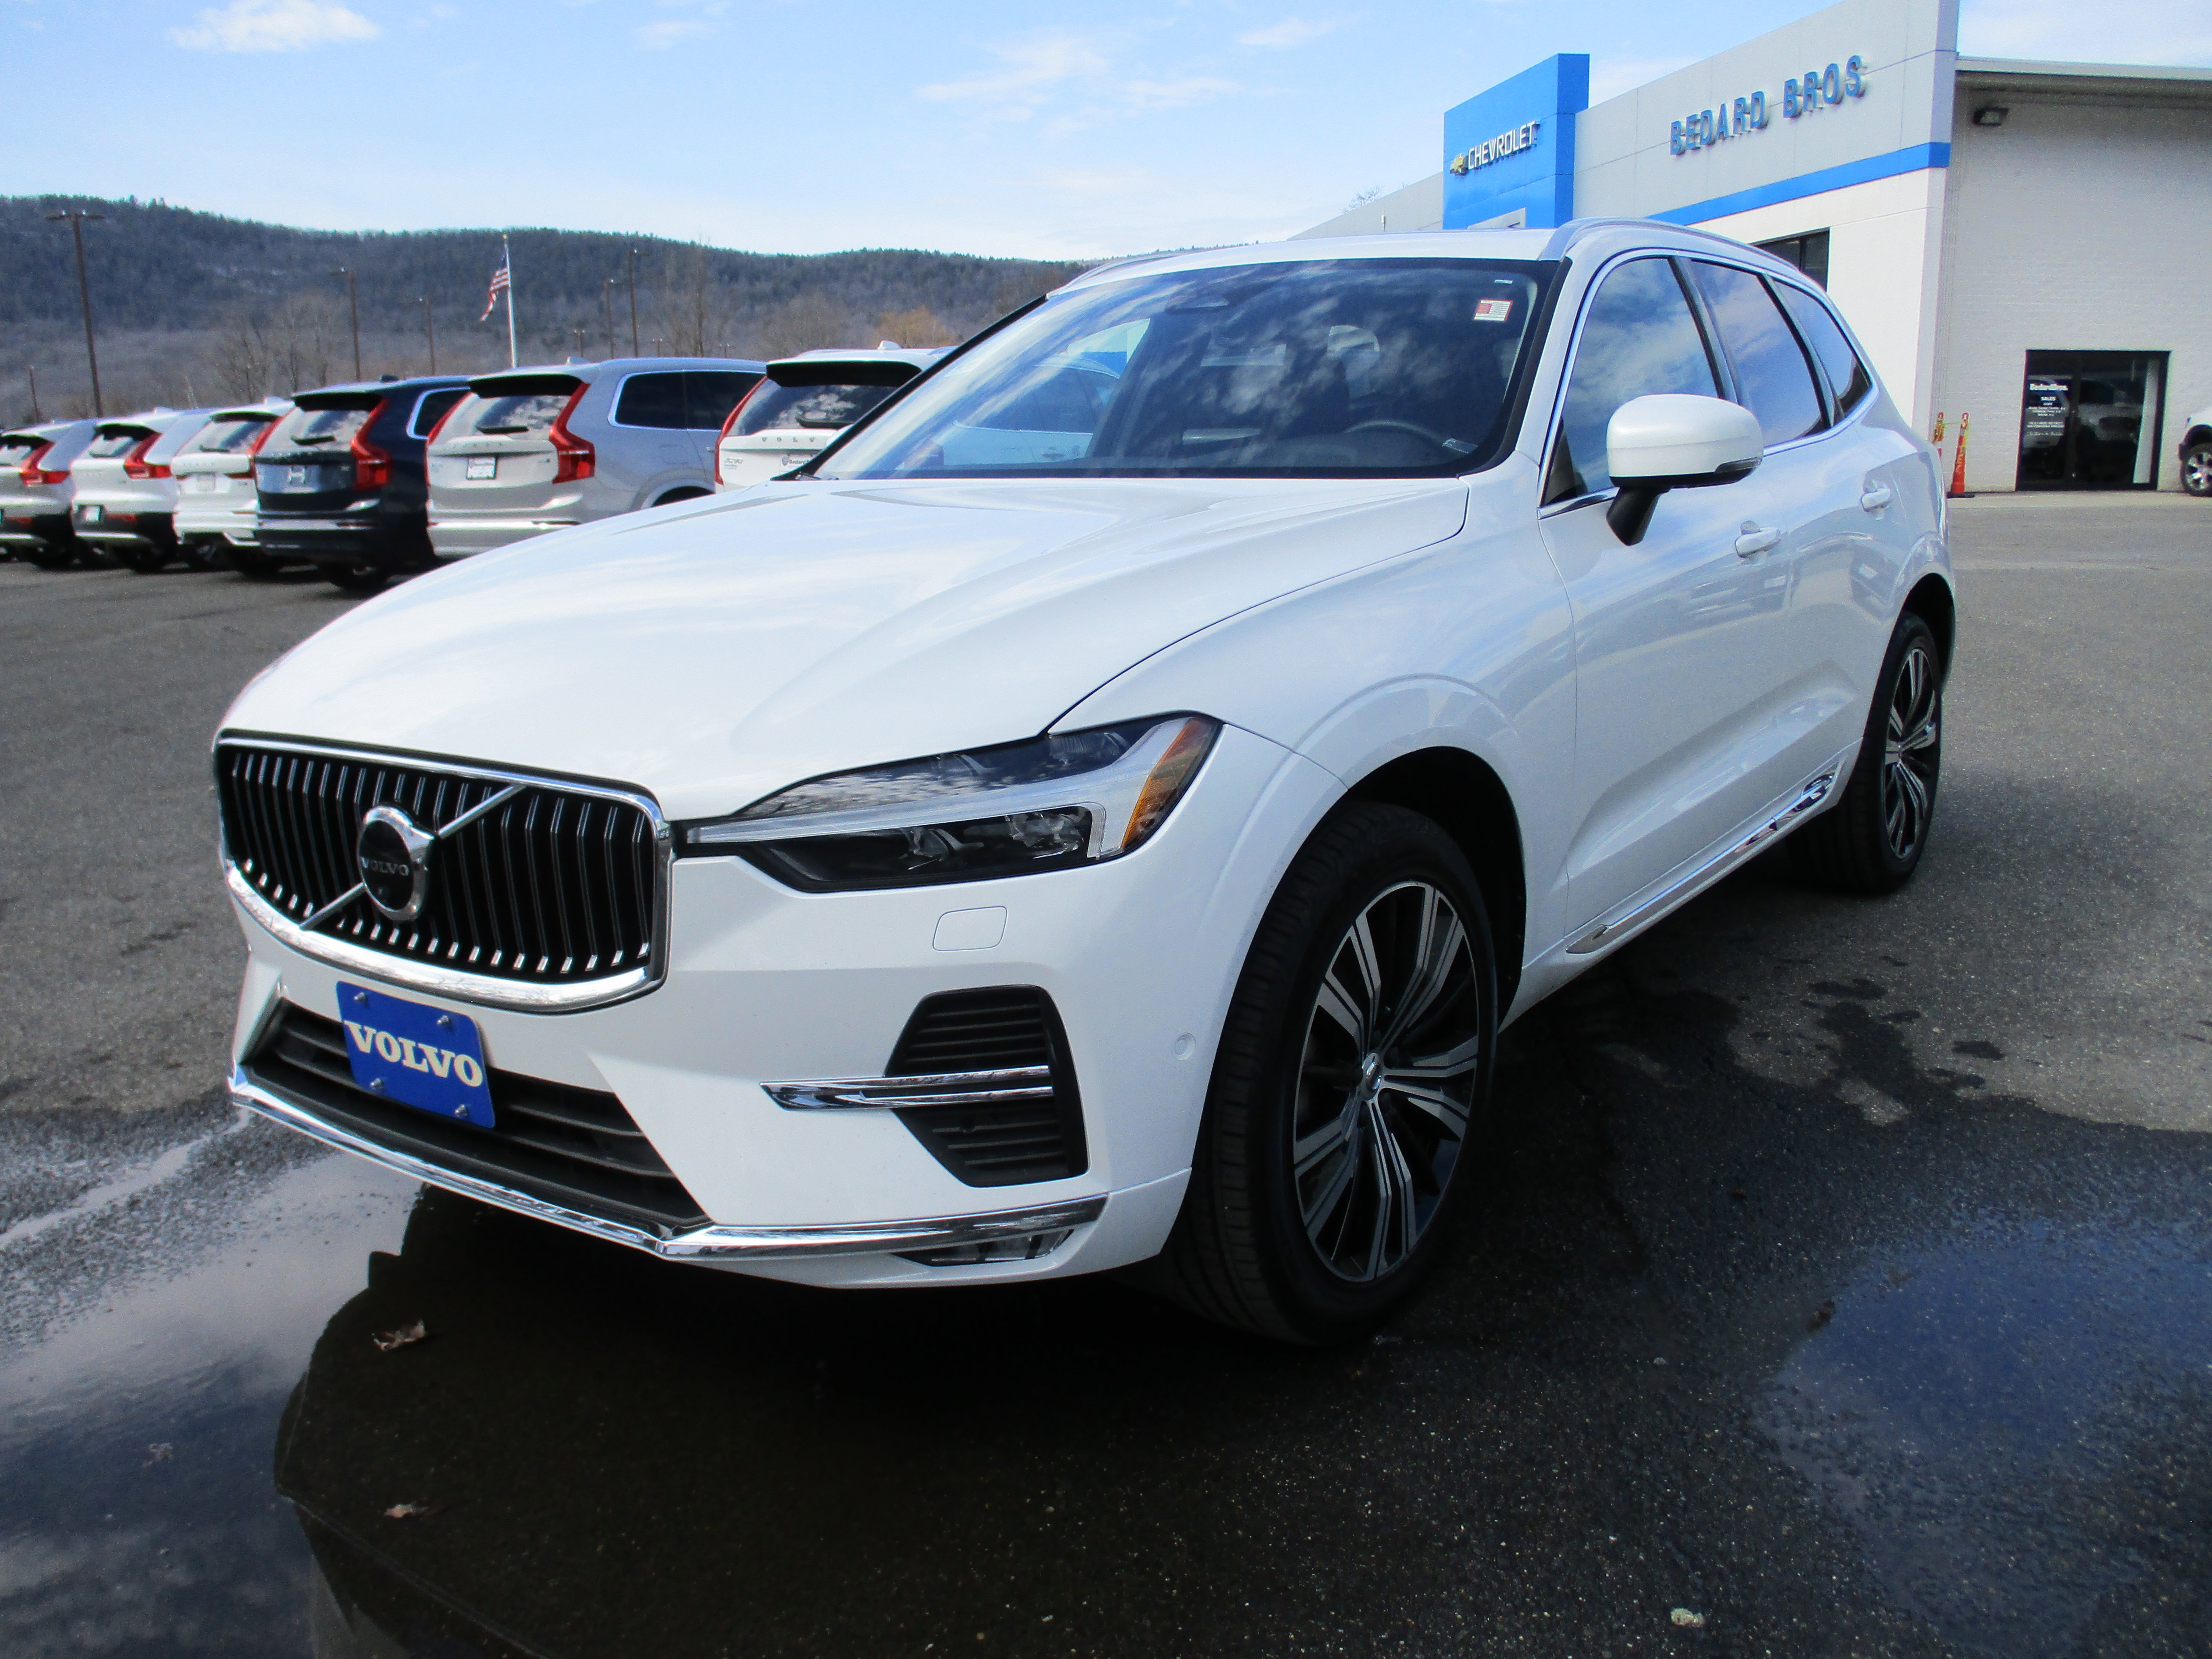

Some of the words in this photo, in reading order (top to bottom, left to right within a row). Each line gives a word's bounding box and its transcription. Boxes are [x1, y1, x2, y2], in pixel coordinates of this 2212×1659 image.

[1670, 91, 1766, 155] BEDARD
[1783, 55, 1862, 118] BROS
[1468, 120, 1537, 170] CHEVROLET
[360, 857, 409, 876] VOLVO
[344, 1020, 483, 1088] VOLVO
